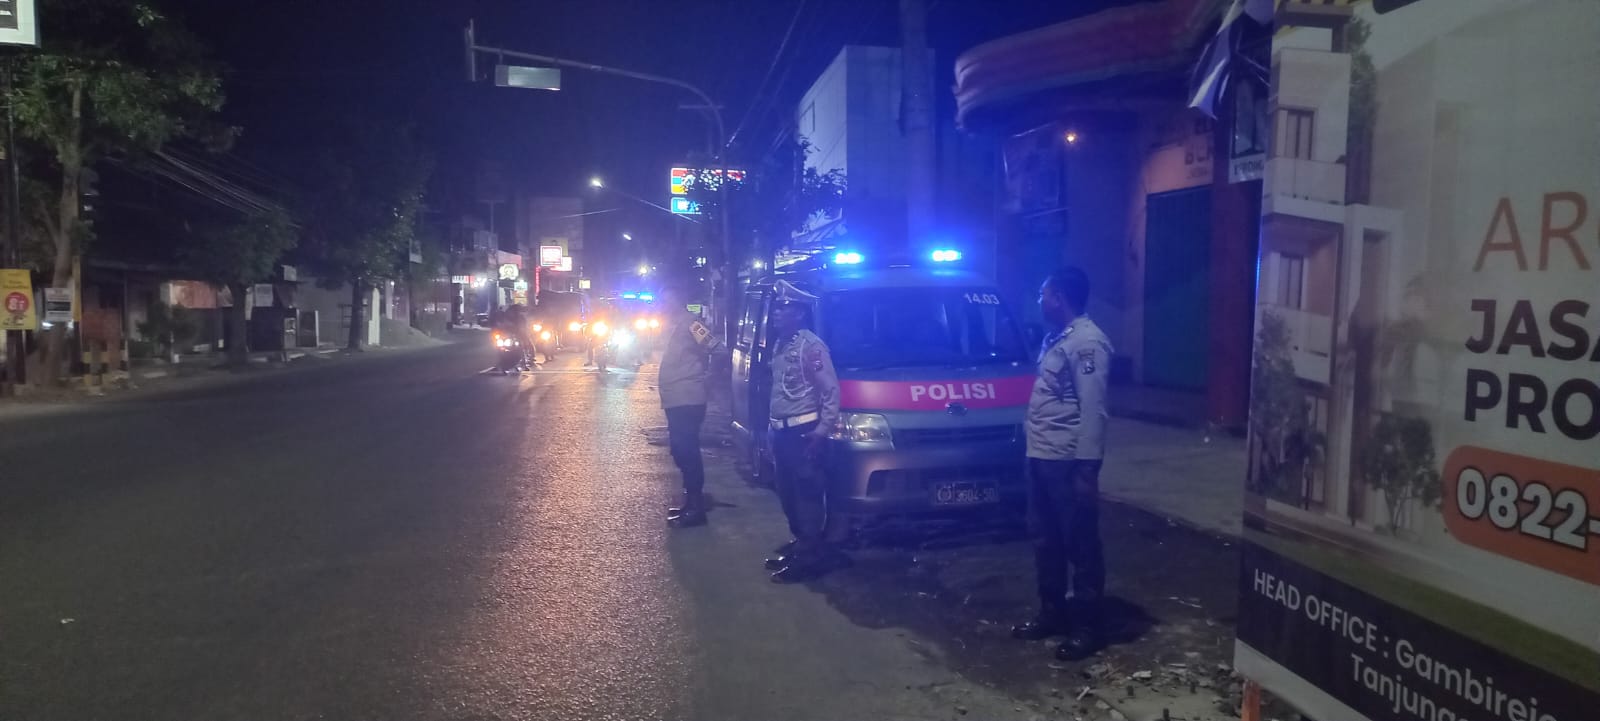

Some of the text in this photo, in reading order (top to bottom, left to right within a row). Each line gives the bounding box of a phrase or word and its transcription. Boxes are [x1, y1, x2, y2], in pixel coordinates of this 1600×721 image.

[1474, 190, 1600, 272] AR
[963, 292, 1000, 305] 14.03
[1465, 298, 1600, 362] JAS
[910, 382, 996, 402] POLISI
[1464, 368, 1600, 441] PRO
[1254, 568, 1300, 611] HEAD
[1304, 594, 1377, 652] OFFICE
[1351, 653, 1469, 721] Tanjun
